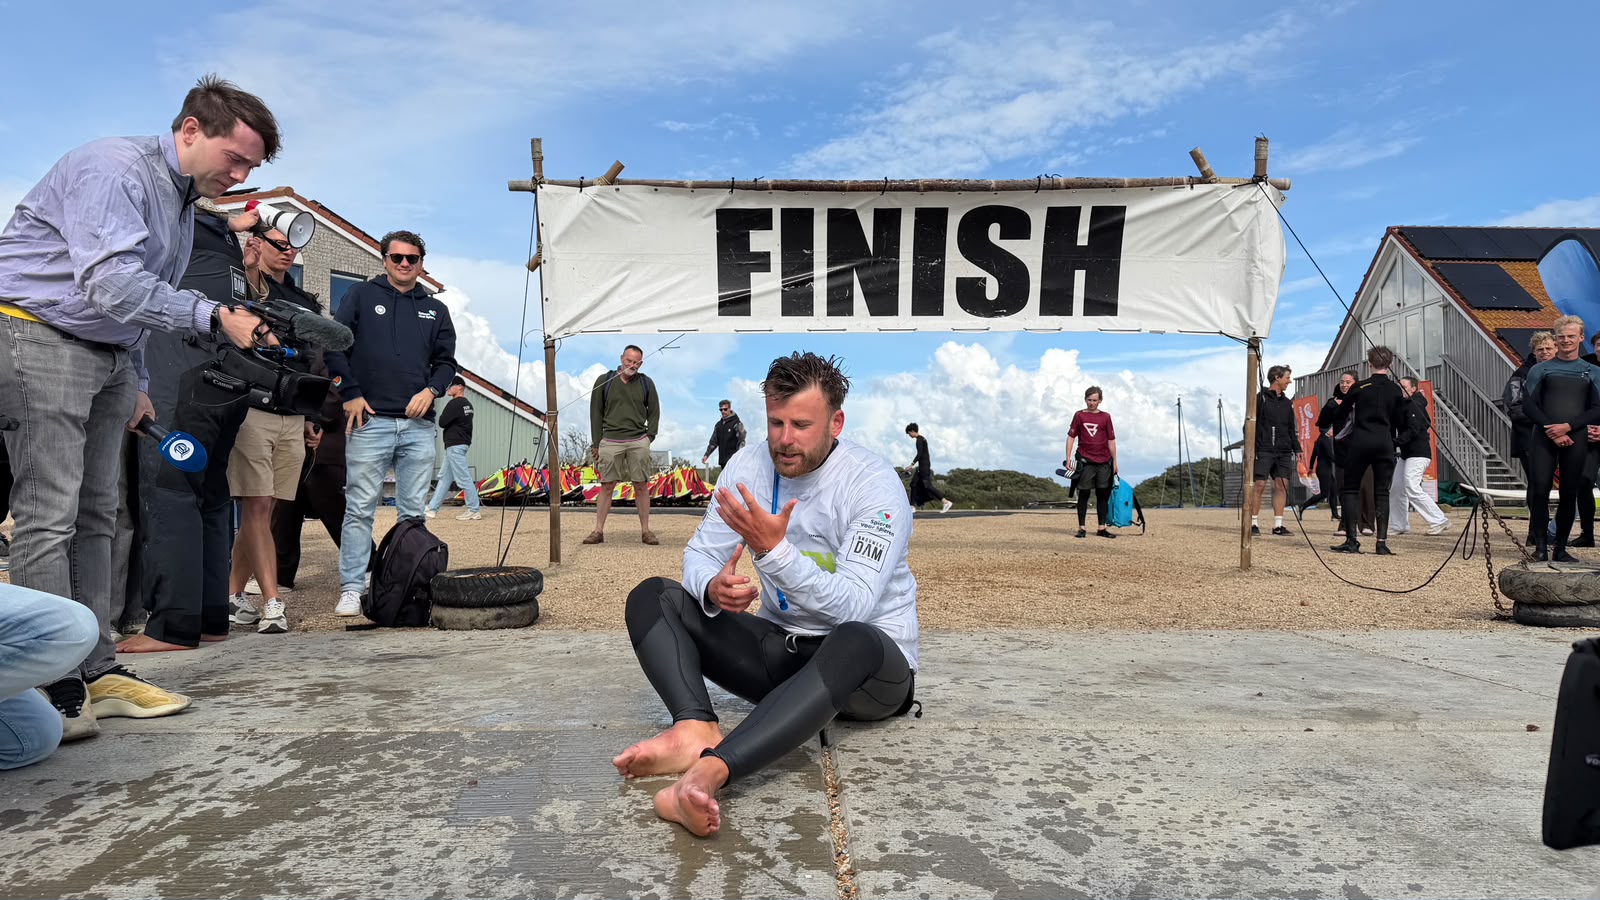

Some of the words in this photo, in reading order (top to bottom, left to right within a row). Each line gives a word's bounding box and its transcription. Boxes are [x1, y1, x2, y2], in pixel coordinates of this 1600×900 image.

[716, 205, 1127, 318] FINISH
[870, 519, 891, 529] Spieren
[853, 541, 883, 562] DAM
